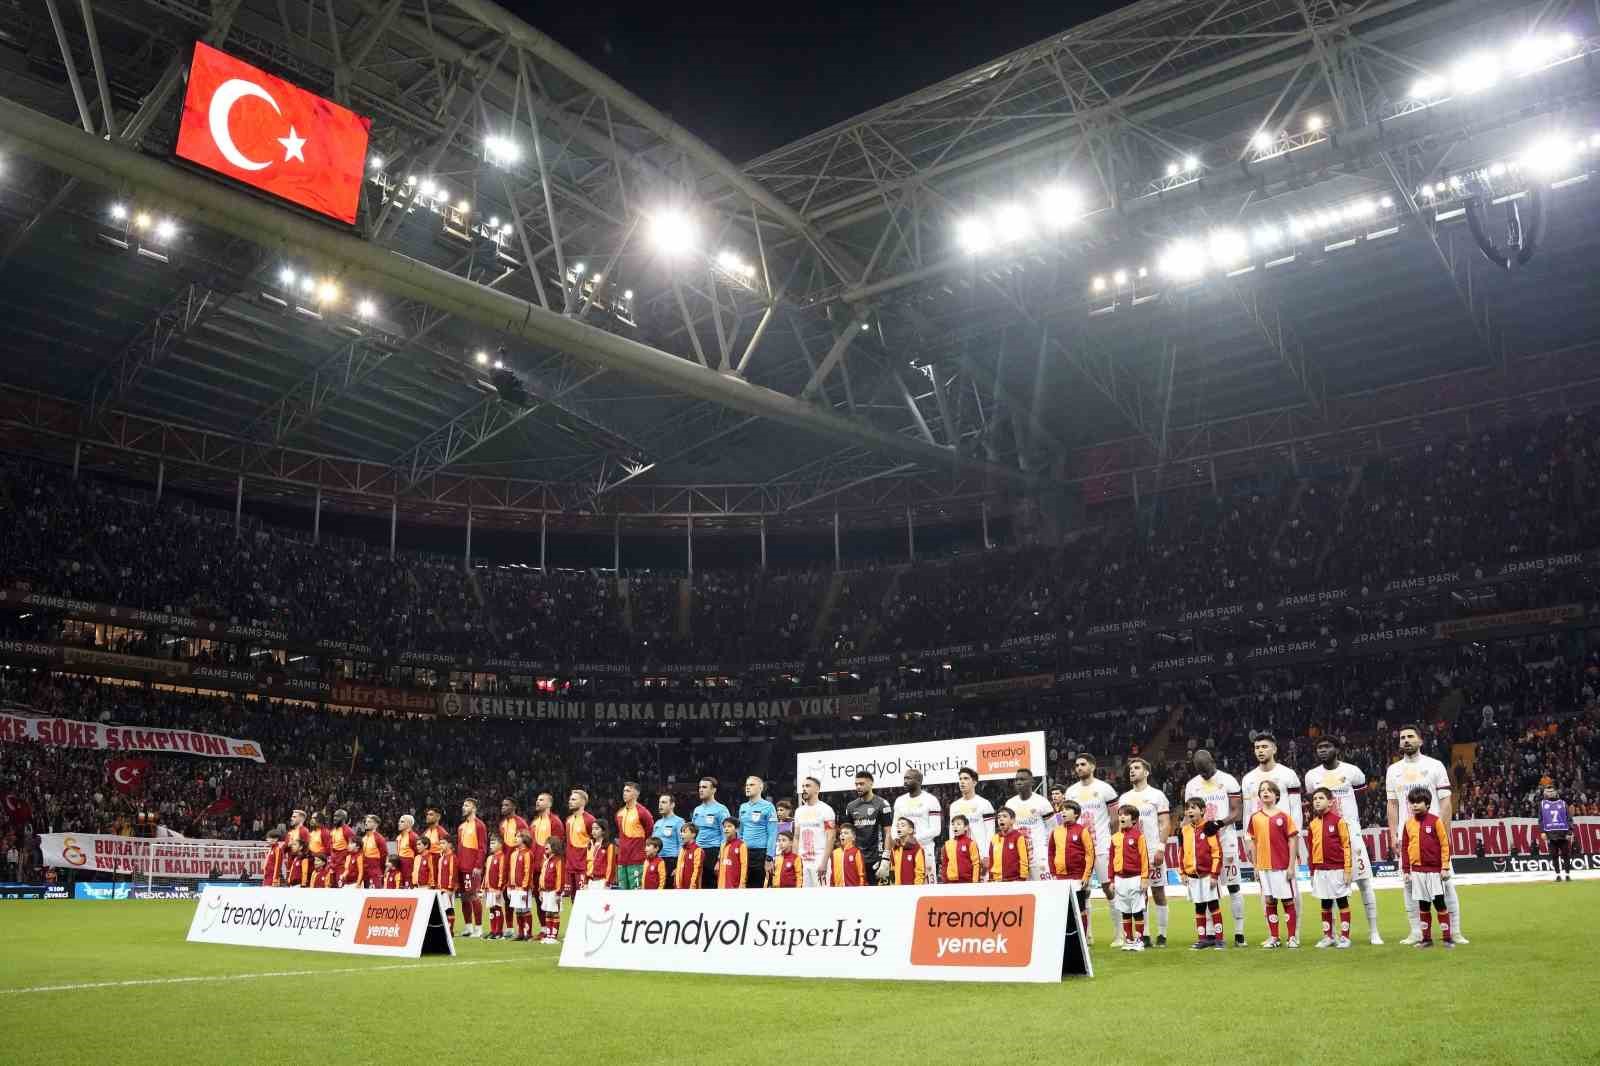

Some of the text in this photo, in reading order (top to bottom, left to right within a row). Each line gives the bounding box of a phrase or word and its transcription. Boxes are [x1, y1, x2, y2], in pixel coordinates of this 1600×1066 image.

[1508, 553, 1583, 573] RAMS PARK
[1392, 572, 1460, 590] RAMS PARK
[32, 594, 96, 611] RAMS PARK
[1286, 589, 1347, 606] RAMS PARK
[139, 610, 196, 627] RAMS PARK
[1184, 605, 1243, 623] RAMS PARK
[235, 625, 289, 641] RAMS PARK
[1093, 619, 1147, 634] RAMS PARK
[1361, 625, 1427, 642] RAMS PARK
[25, 645, 56, 656] PARK
[1255, 640, 1316, 657] RAMS PARK
[1159, 655, 1215, 669] RAMS PARK
[201, 667, 255, 681] RAMS PARK
[1066, 665, 1119, 681] RAMS PARK
[290, 679, 317, 689] RAMS
[664, 701, 792, 720] GALATASARAY
[800, 698, 840, 719] YOK!
[36, 719, 98, 747] SÖKE
[982, 745, 1026, 760] trendyol
[830, 756, 969, 779] trendyol SüperLig
[988, 759, 1021, 771] yemek
[1550, 810, 1559, 823] 7
[1449, 821, 1509, 857] DEKİ
[1225, 865, 1237, 877] 70
[1357, 858, 1365, 871] 3
[1150, 867, 1161, 880] 28
[221, 903, 345, 938] trendyol SüperLig
[366, 903, 412, 922] trendyol
[927, 905, 1024, 931] trendyol
[366, 924, 401, 938] yemek
[620, 911, 881, 956] trendyol SüperLig
[936, 934, 1009, 958] yemek
